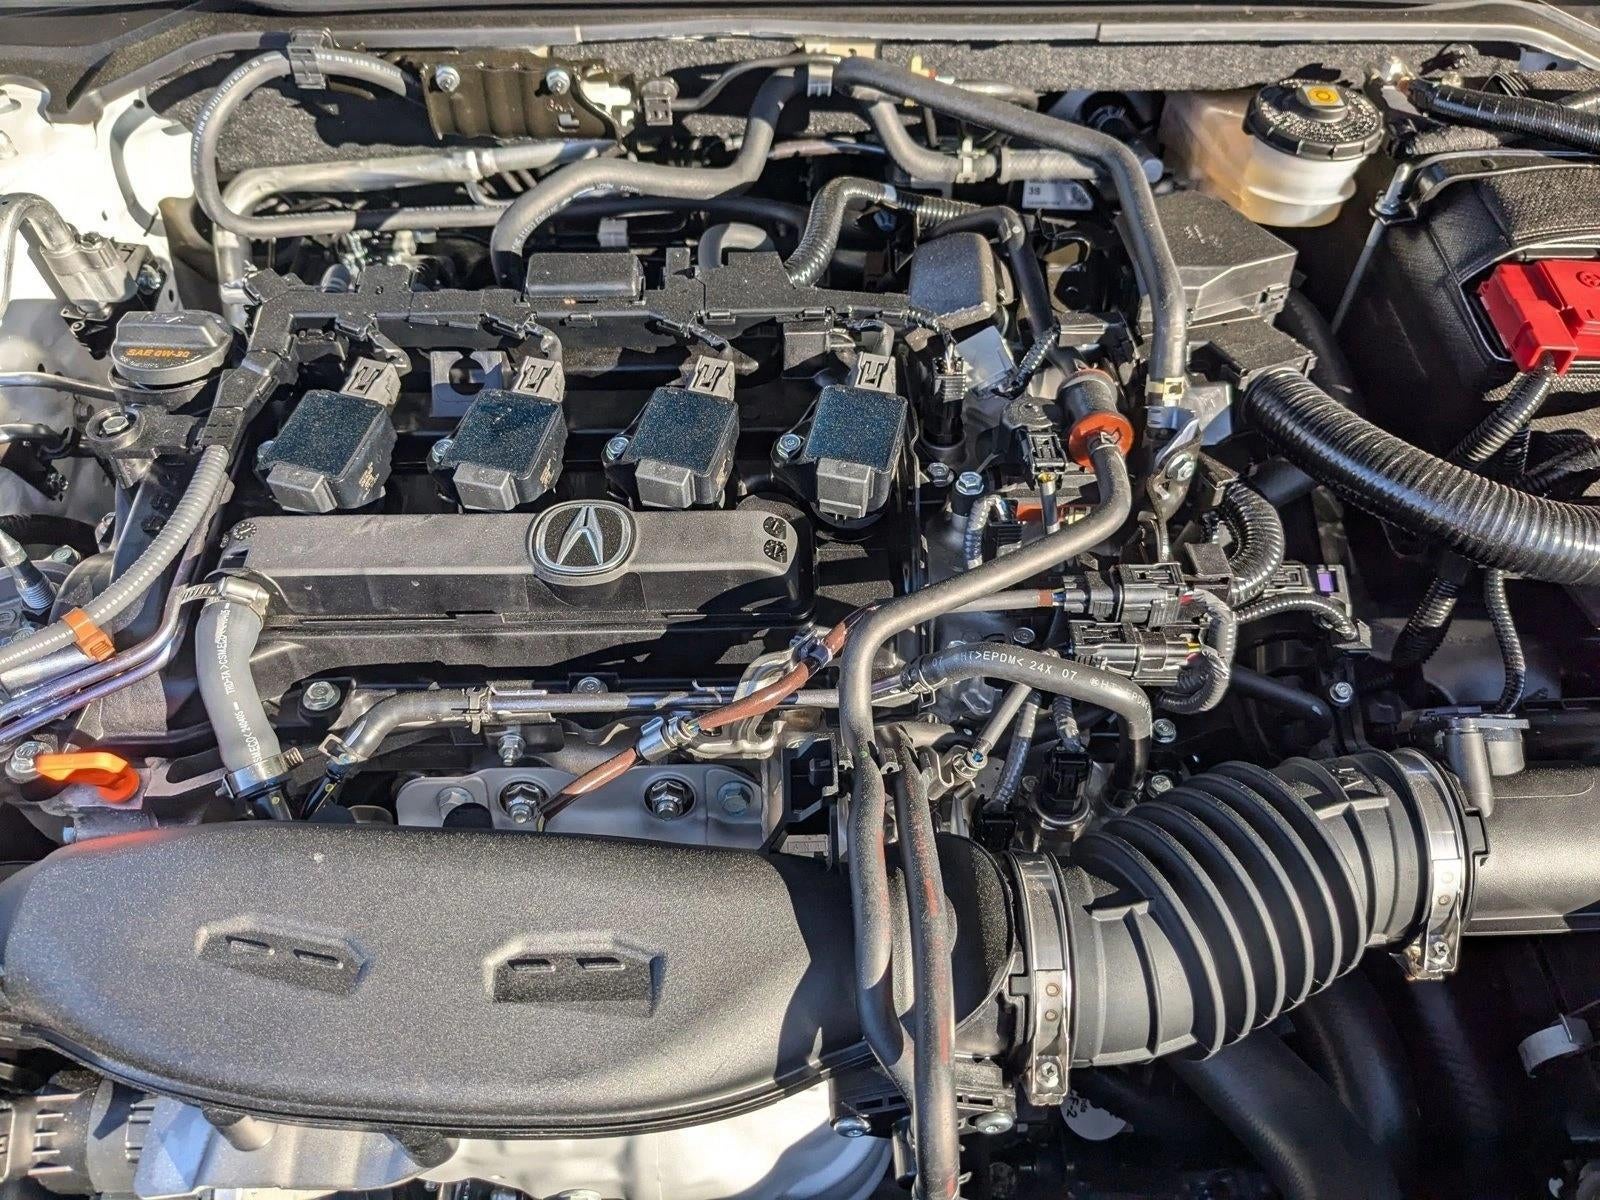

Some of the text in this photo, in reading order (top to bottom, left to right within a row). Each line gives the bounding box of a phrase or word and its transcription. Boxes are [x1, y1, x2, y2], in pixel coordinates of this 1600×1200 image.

[126, 348, 191, 358] SAE 0W-20
[1029, 660, 1053, 675] 24X
[1061, 668, 1078, 680] 07
